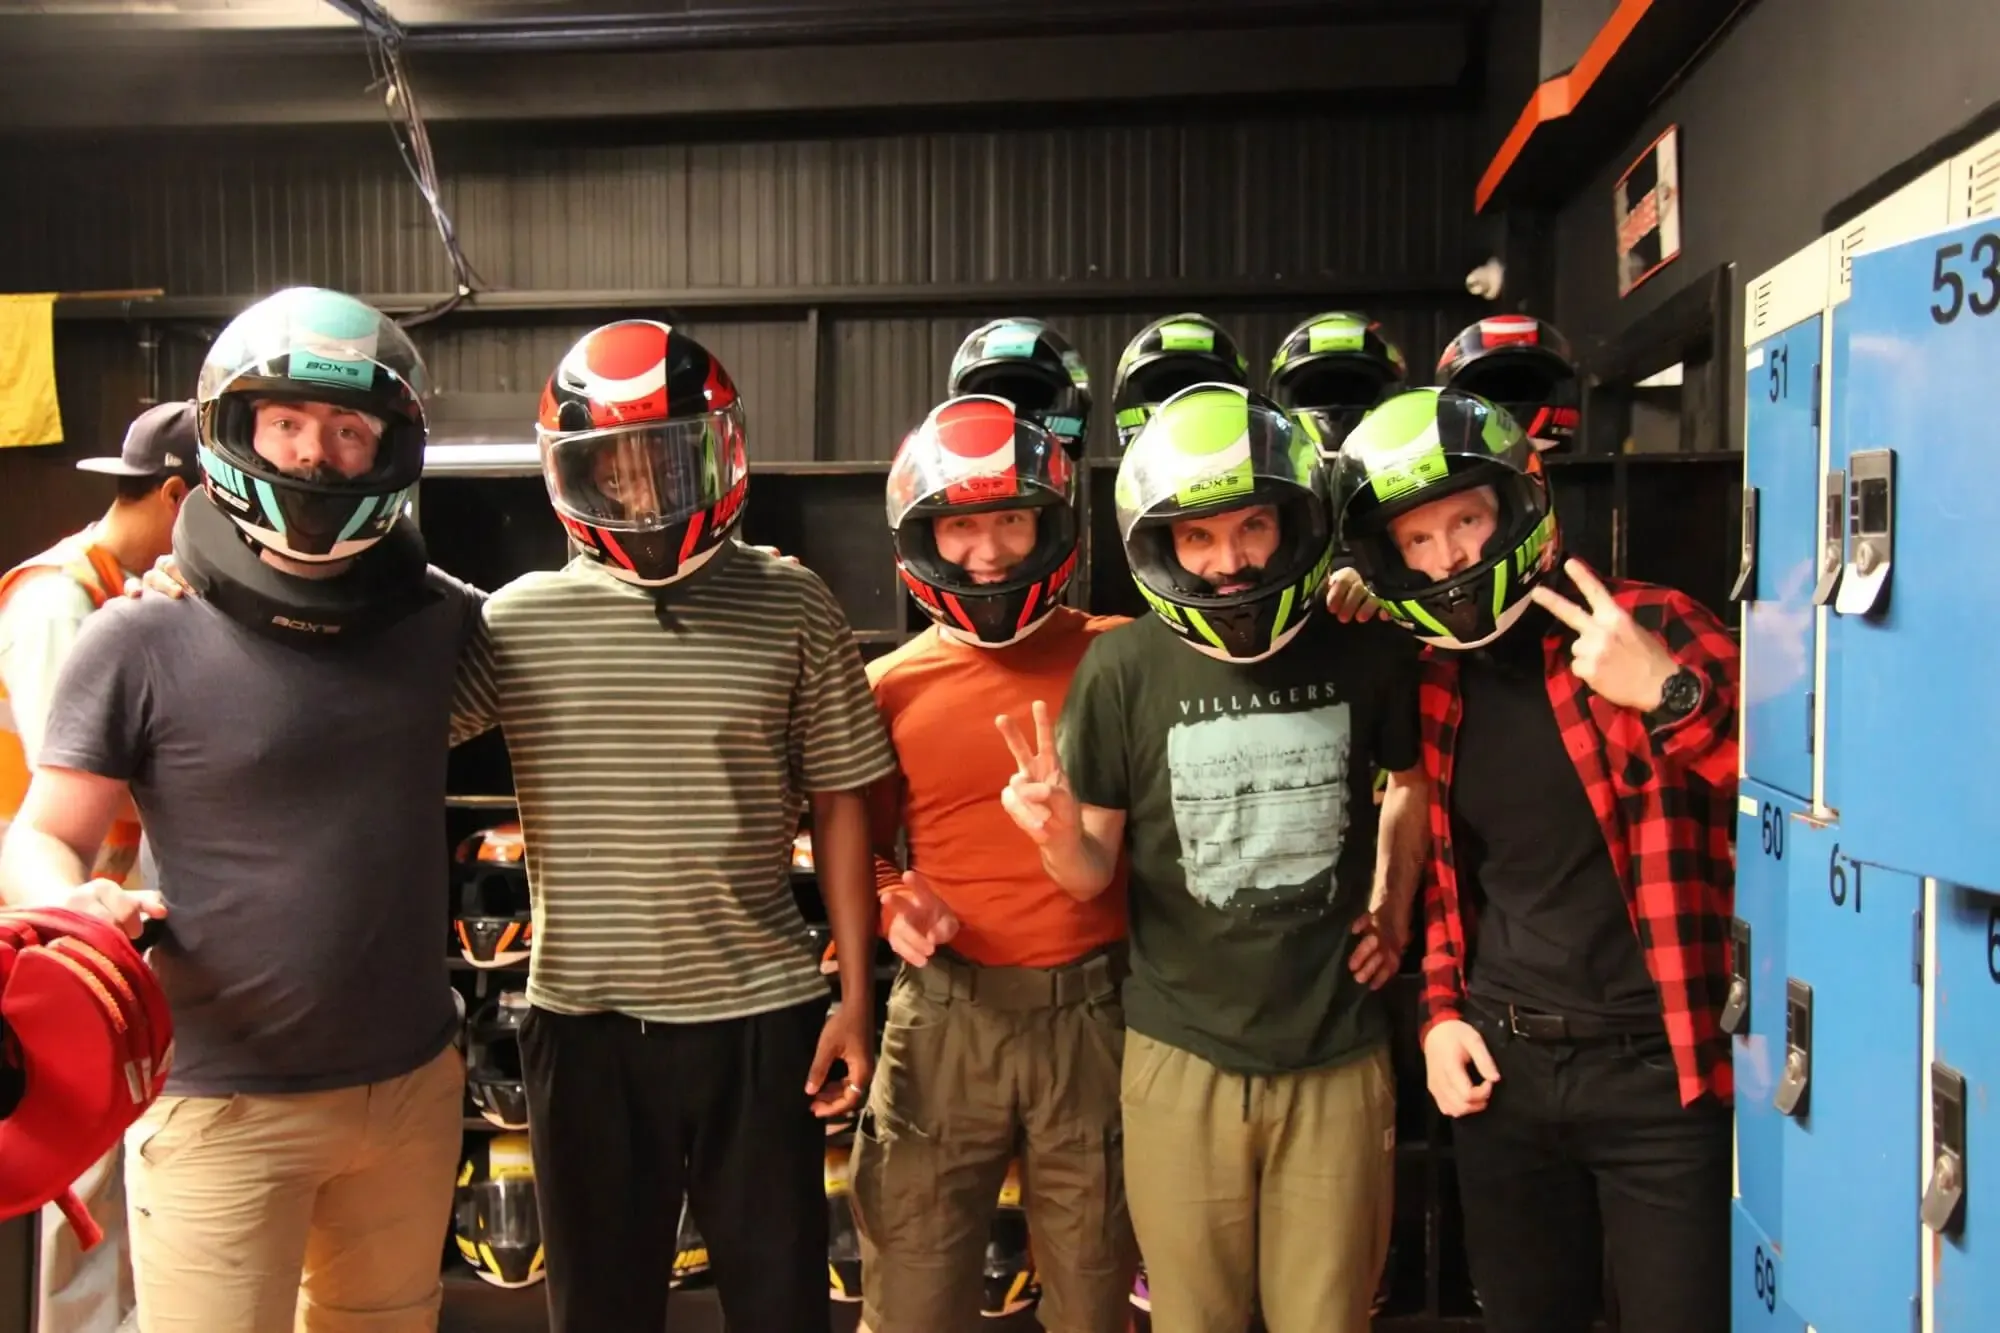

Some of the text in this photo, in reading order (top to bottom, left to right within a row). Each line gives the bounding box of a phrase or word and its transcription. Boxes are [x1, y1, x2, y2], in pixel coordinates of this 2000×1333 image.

[1930, 233, 2000, 325] 53
[1769, 344, 1788, 403] 51
[1179, 682, 1335, 715] VILLAGERS
[1762, 801, 1784, 860] 60
[1829, 842, 1862, 914] 61
[1754, 1245, 1776, 1316] 69
